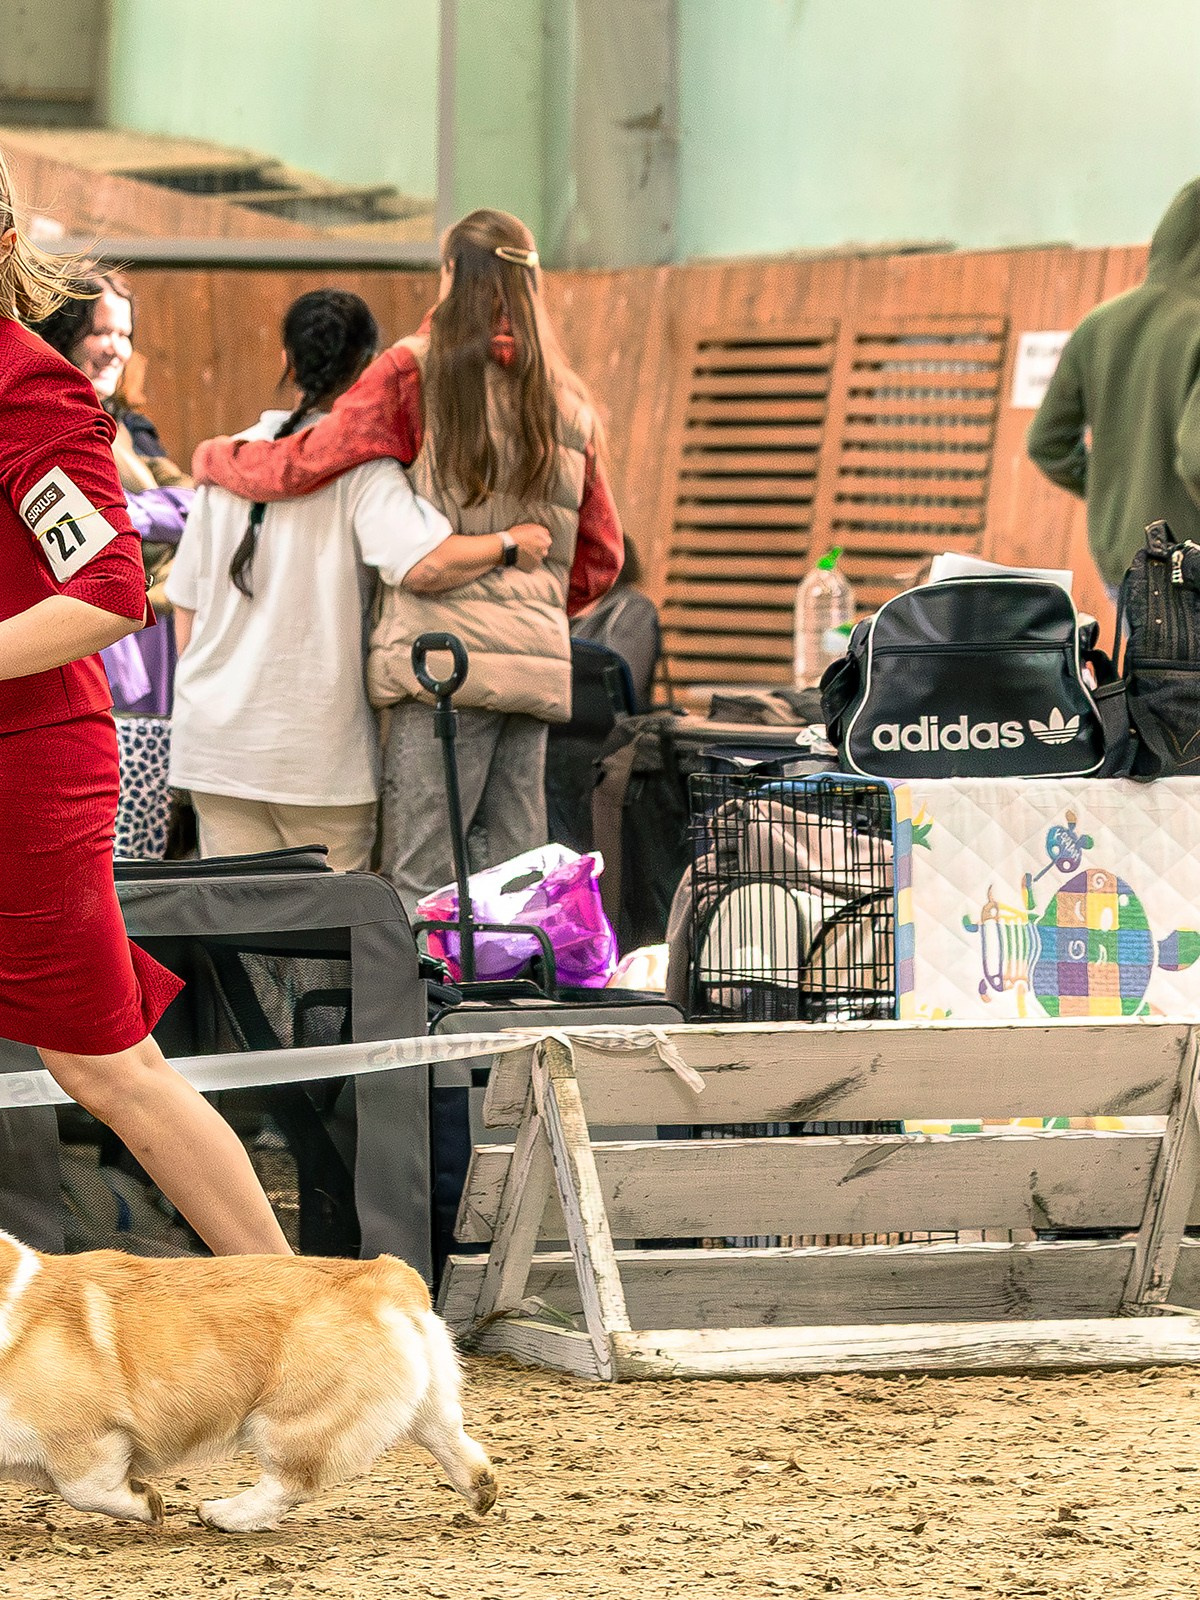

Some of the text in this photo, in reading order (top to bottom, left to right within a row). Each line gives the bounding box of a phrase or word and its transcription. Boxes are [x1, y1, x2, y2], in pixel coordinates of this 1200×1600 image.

[27, 487, 57, 523] SIRIUS
[45, 512, 87, 562] 21
[872, 715, 1025, 751] adidas
